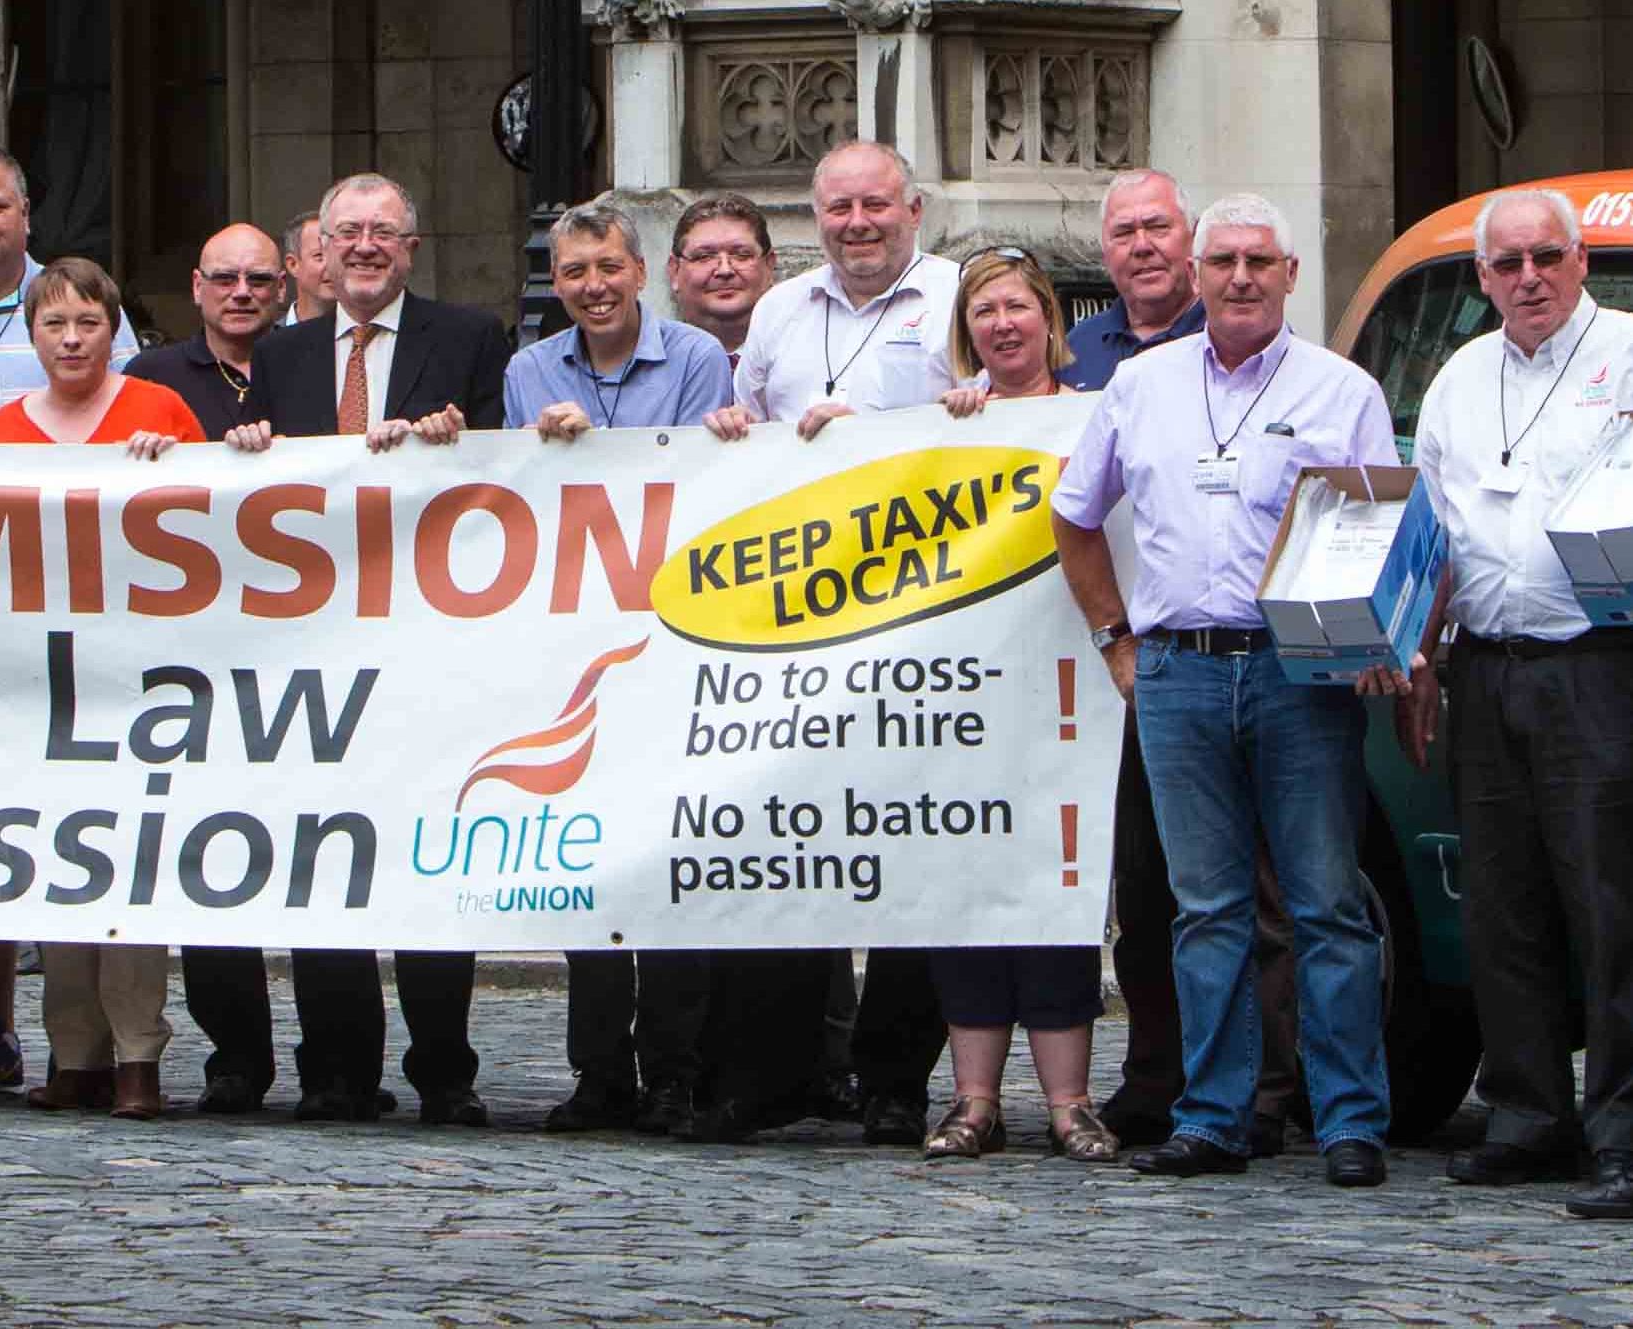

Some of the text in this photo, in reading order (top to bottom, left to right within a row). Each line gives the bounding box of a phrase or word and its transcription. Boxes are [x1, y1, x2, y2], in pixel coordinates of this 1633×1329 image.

[688, 465, 1041, 594] KEEP TAXI'S
[772, 541, 963, 628] LOCAL
[45, 631, 381, 764] Law
[694, 656, 1003, 706] No to cross-
[685, 698, 985, 757] border hire
[413, 803, 602, 876] unite
[671, 787, 1014, 839] No to baton
[670, 842, 883, 903] passing
